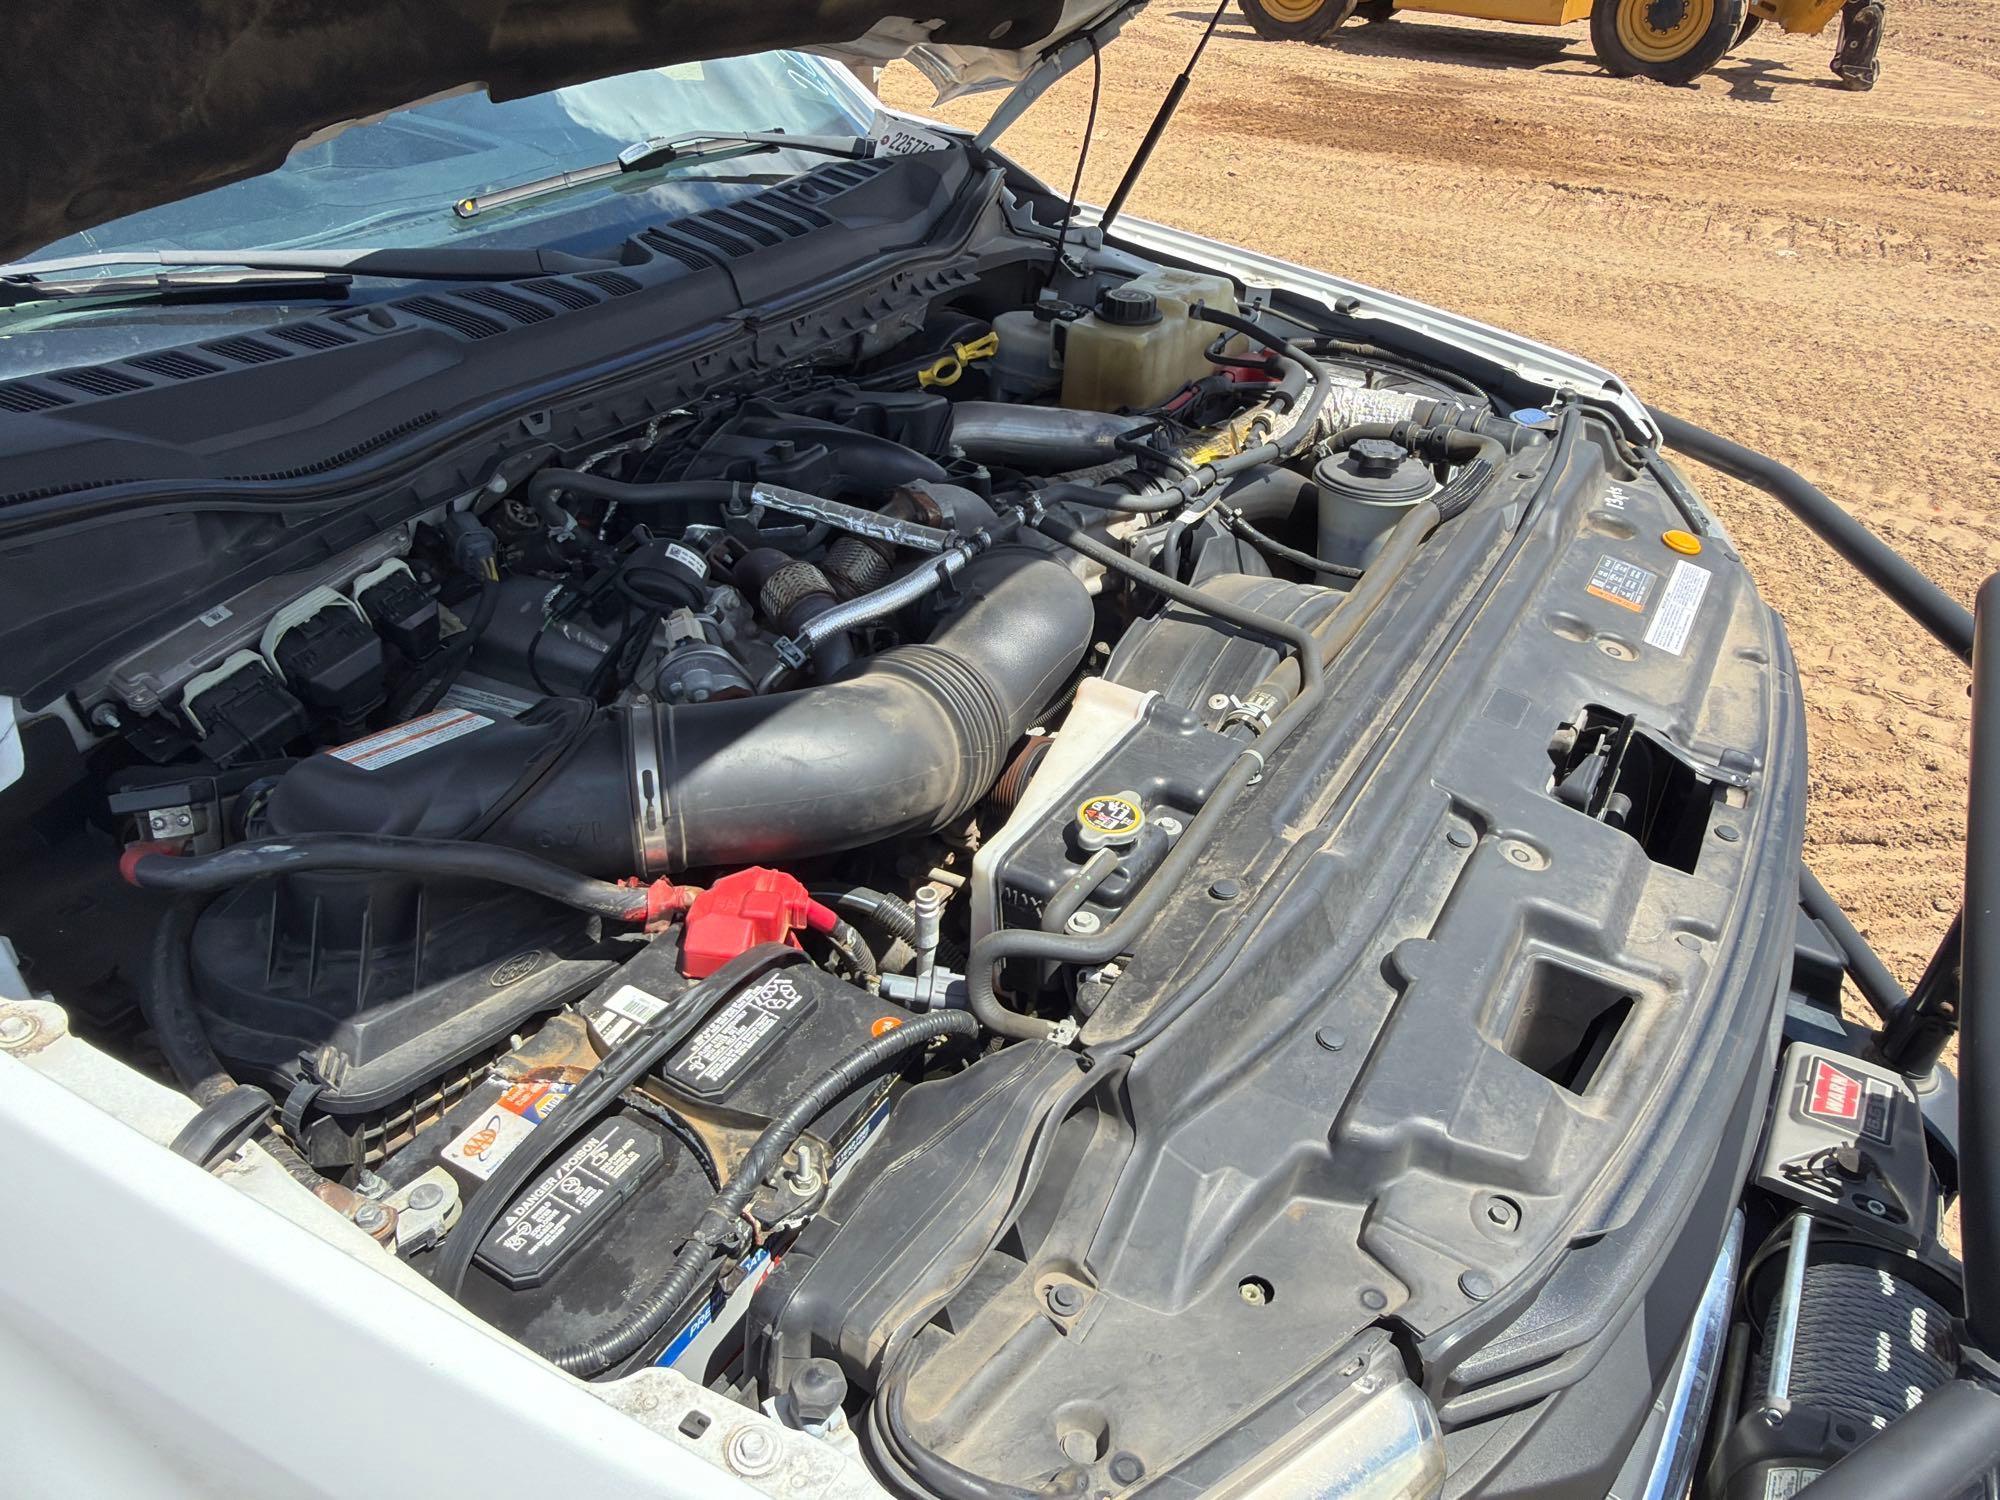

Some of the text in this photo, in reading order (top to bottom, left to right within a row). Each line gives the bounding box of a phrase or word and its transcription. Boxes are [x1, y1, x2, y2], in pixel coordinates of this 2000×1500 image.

[1826, 1073, 1849, 1113] WARN
[464, 1129, 496, 1156] AAA
[514, 1175, 558, 1217] DANGER
[562, 1136, 599, 1171] POISON
